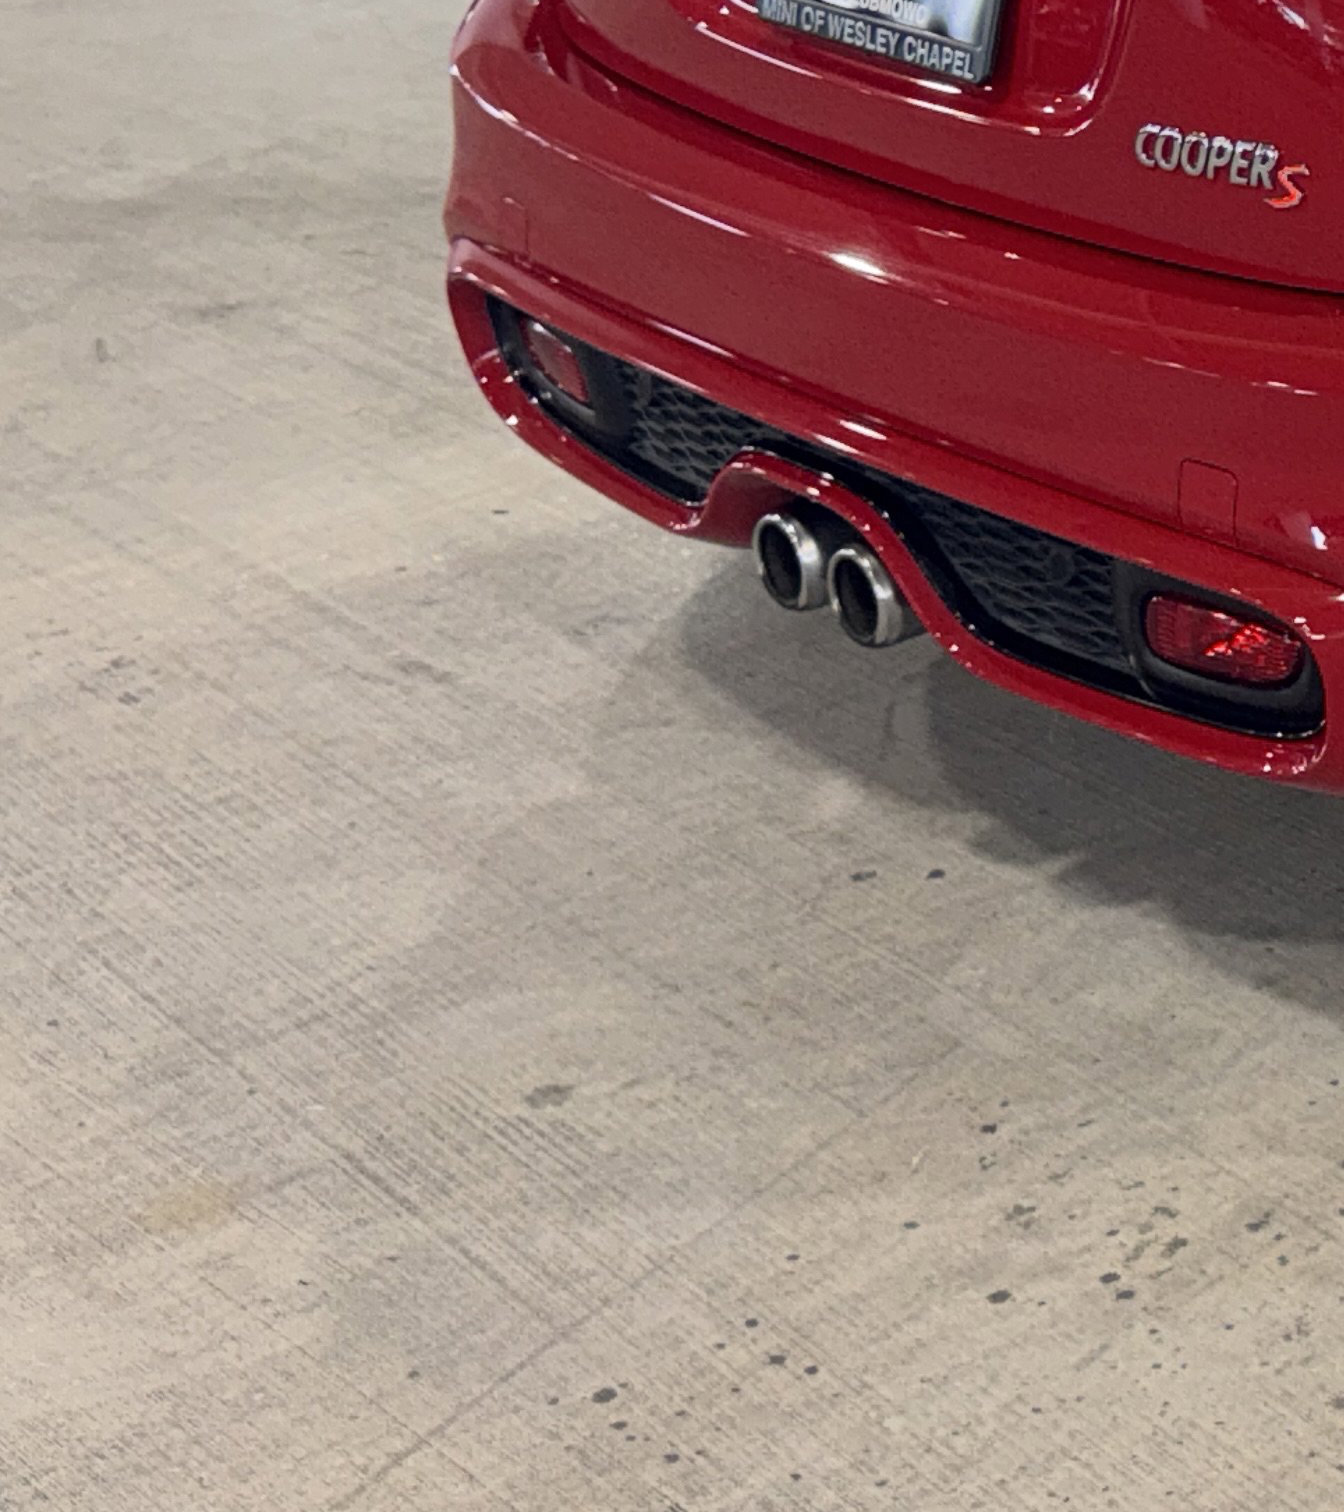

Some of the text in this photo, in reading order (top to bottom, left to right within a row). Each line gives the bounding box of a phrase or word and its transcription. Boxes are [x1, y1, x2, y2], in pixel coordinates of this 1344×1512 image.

[801, 6, 827, 33] OF
[828, 14, 901, 56] WESLEY
[903, 36, 975, 79] CHAPEL
[1135, 123, 1311, 208] COOPER S
